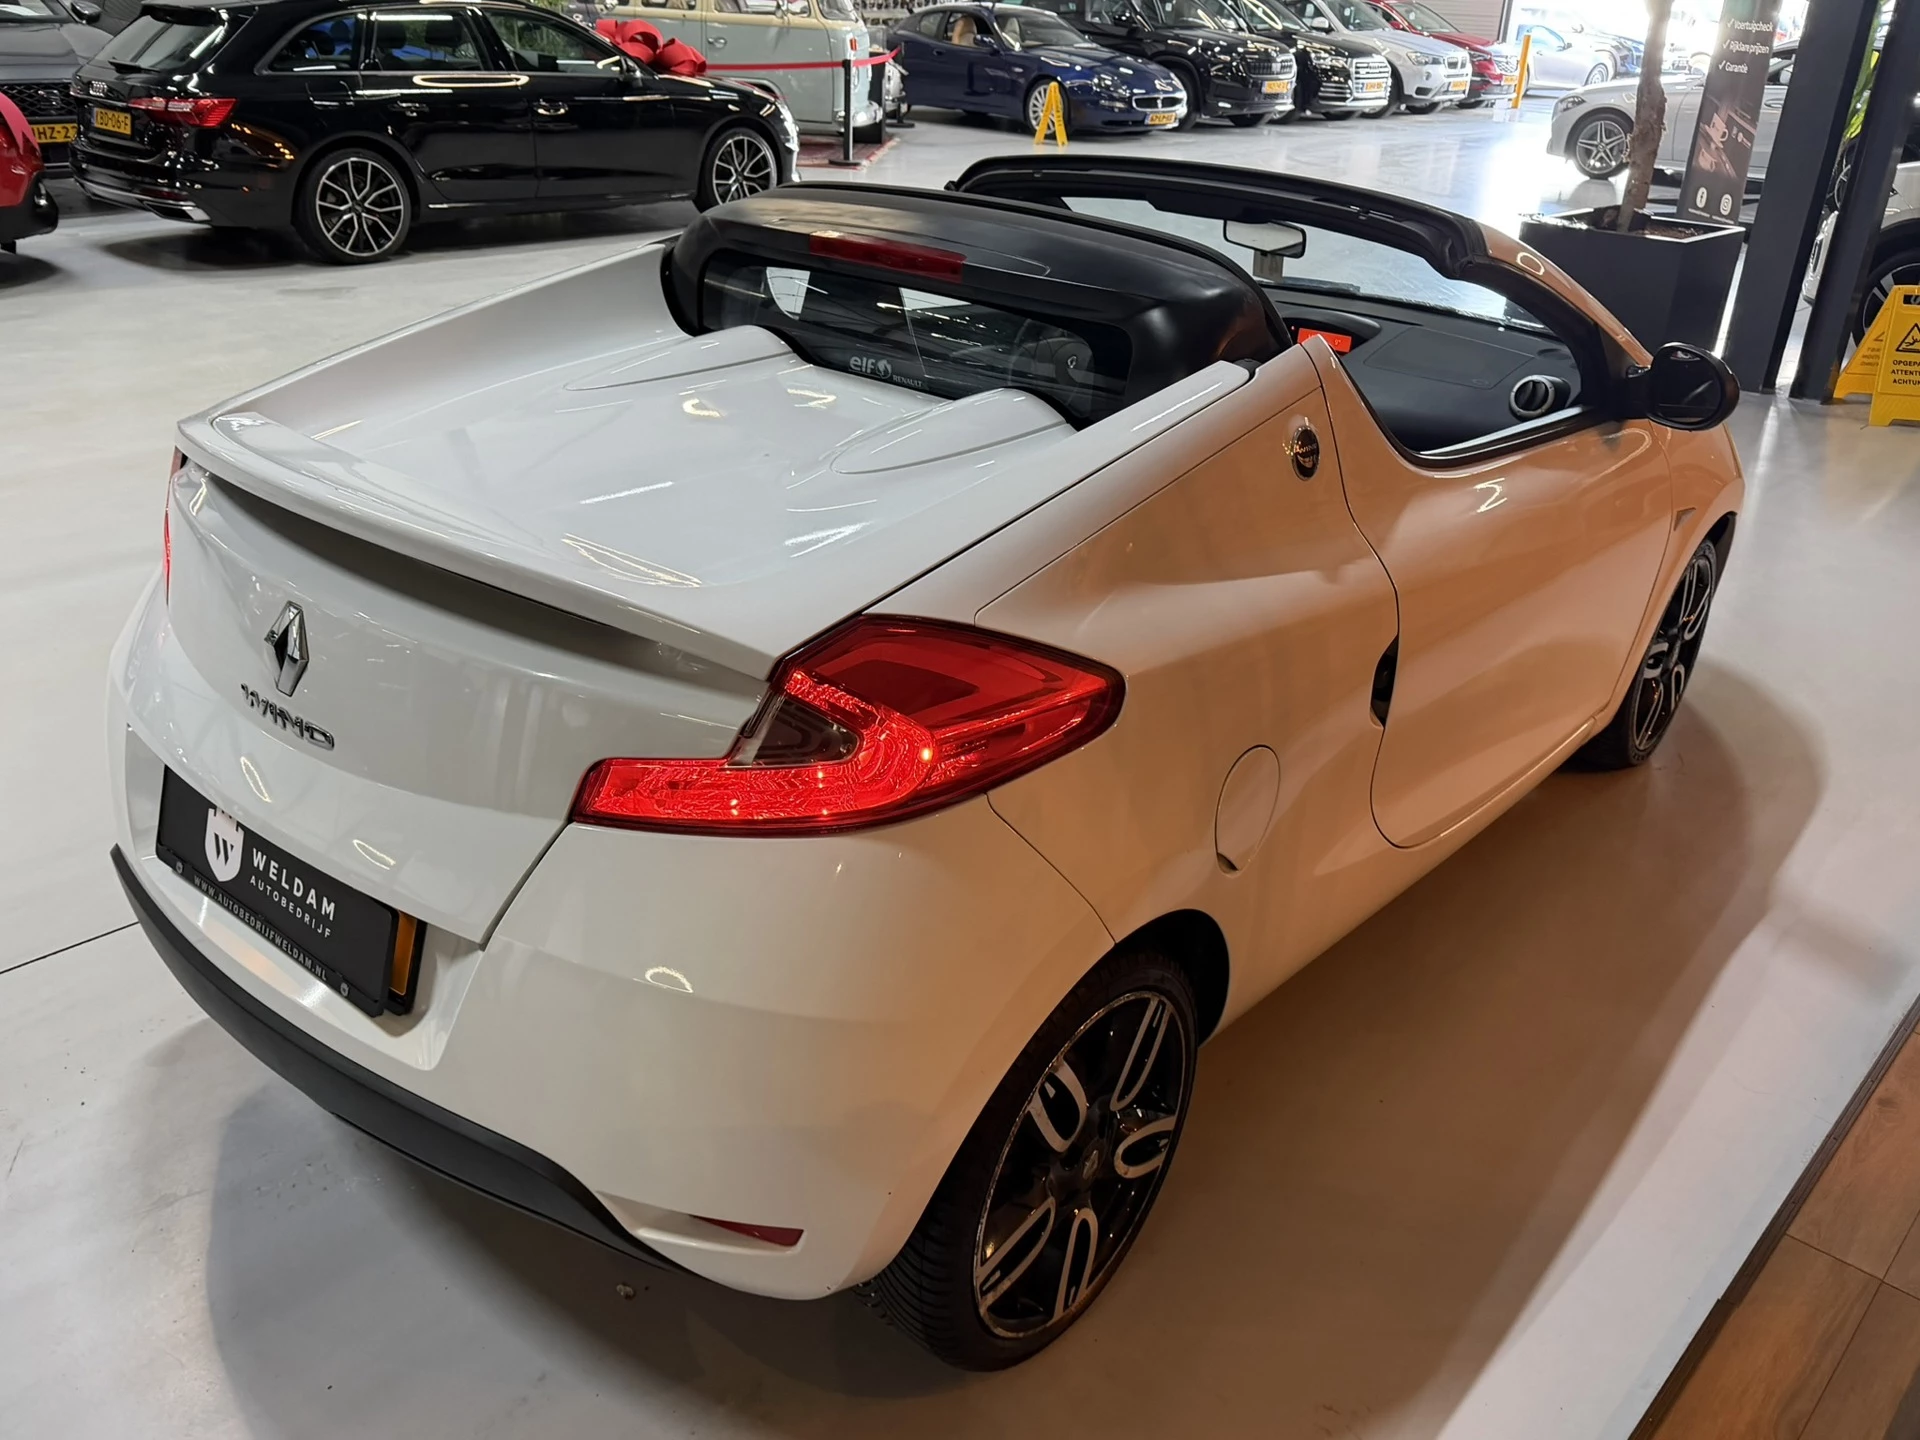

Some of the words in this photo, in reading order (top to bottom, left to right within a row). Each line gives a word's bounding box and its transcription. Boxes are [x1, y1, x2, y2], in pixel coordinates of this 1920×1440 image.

[849, 356, 876, 374] elf
[892, 375, 922, 387] RENAULT
[249, 875, 332, 938] AUTOBEDRIJF
[252, 848, 336, 921] WELDAM
[194, 875, 328, 981] WWW.AUTOBEDRIJFWELDAM.NL
